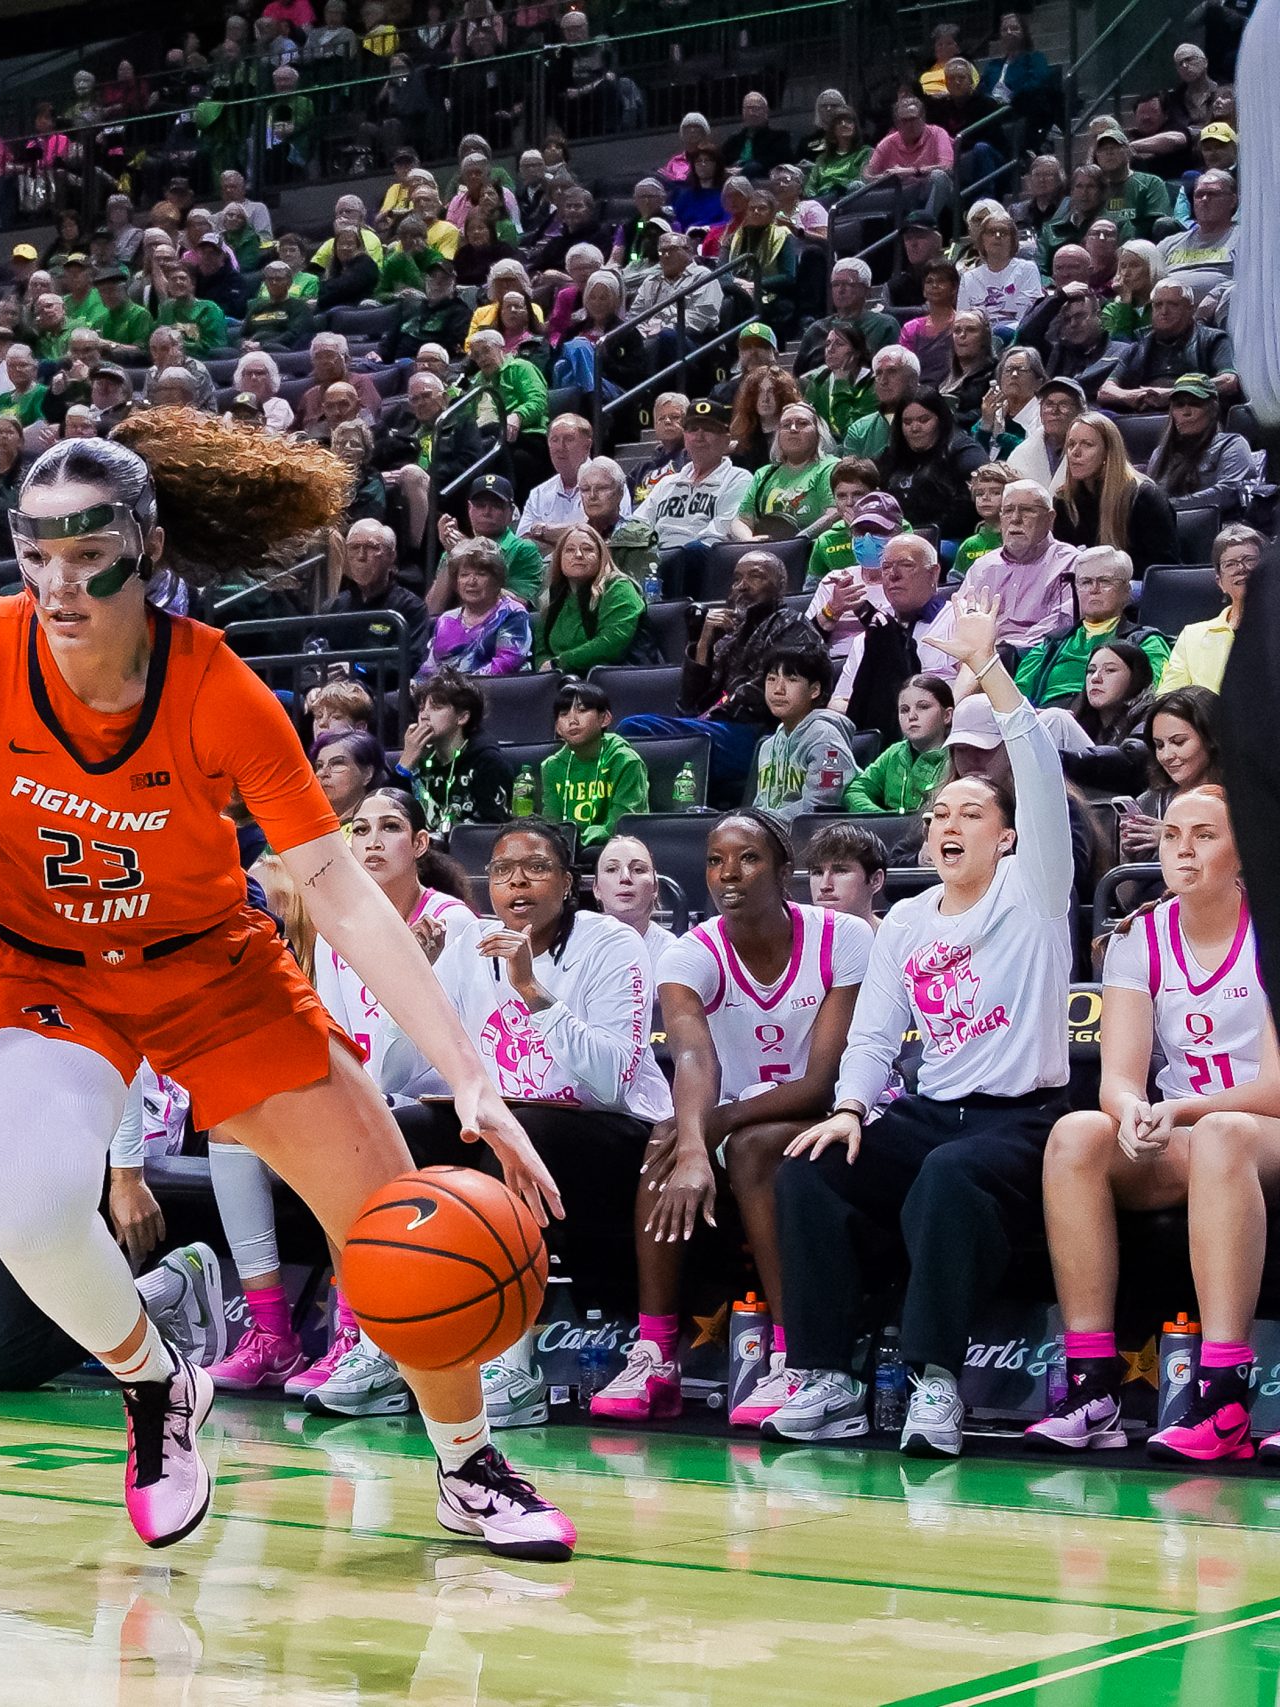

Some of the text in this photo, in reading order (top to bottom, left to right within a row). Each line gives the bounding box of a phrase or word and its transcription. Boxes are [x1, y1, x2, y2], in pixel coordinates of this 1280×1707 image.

[10, 775, 171, 832] FIGHTING
[37, 826, 144, 890] 23
[955, 1005, 1011, 1044] CANCER
[1184, 1052, 1236, 1096] 21
[964, 1337, 1029, 1370] arl's
